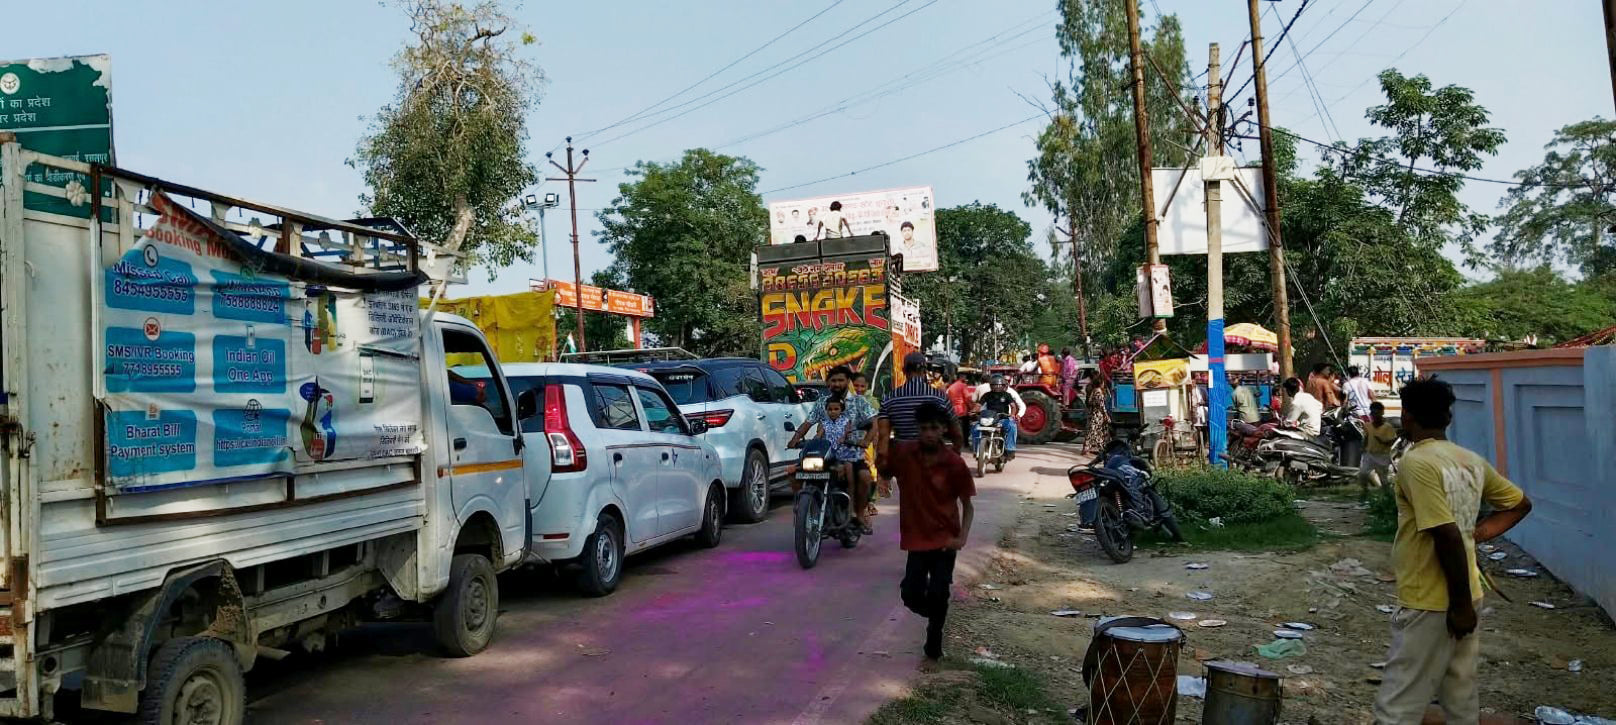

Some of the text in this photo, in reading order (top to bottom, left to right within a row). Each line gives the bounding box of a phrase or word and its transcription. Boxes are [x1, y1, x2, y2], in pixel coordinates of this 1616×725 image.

[10, 99, 22, 110] का
[28, 94, 51, 108] प्रदेश
[13, 109, 36, 123] प्रदेश
[114, 280, 188, 302] 8454955555
[763, 284, 889, 341] SNAKE
[107, 344, 195, 364] SMS/IVR Booking
[225, 347, 260, 364] Indian
[123, 362, 182, 377] 7718955555
[228, 367, 274, 385] One App
[126, 423, 182, 440] Bharat Bill
[110, 442, 195, 462] Payment system
